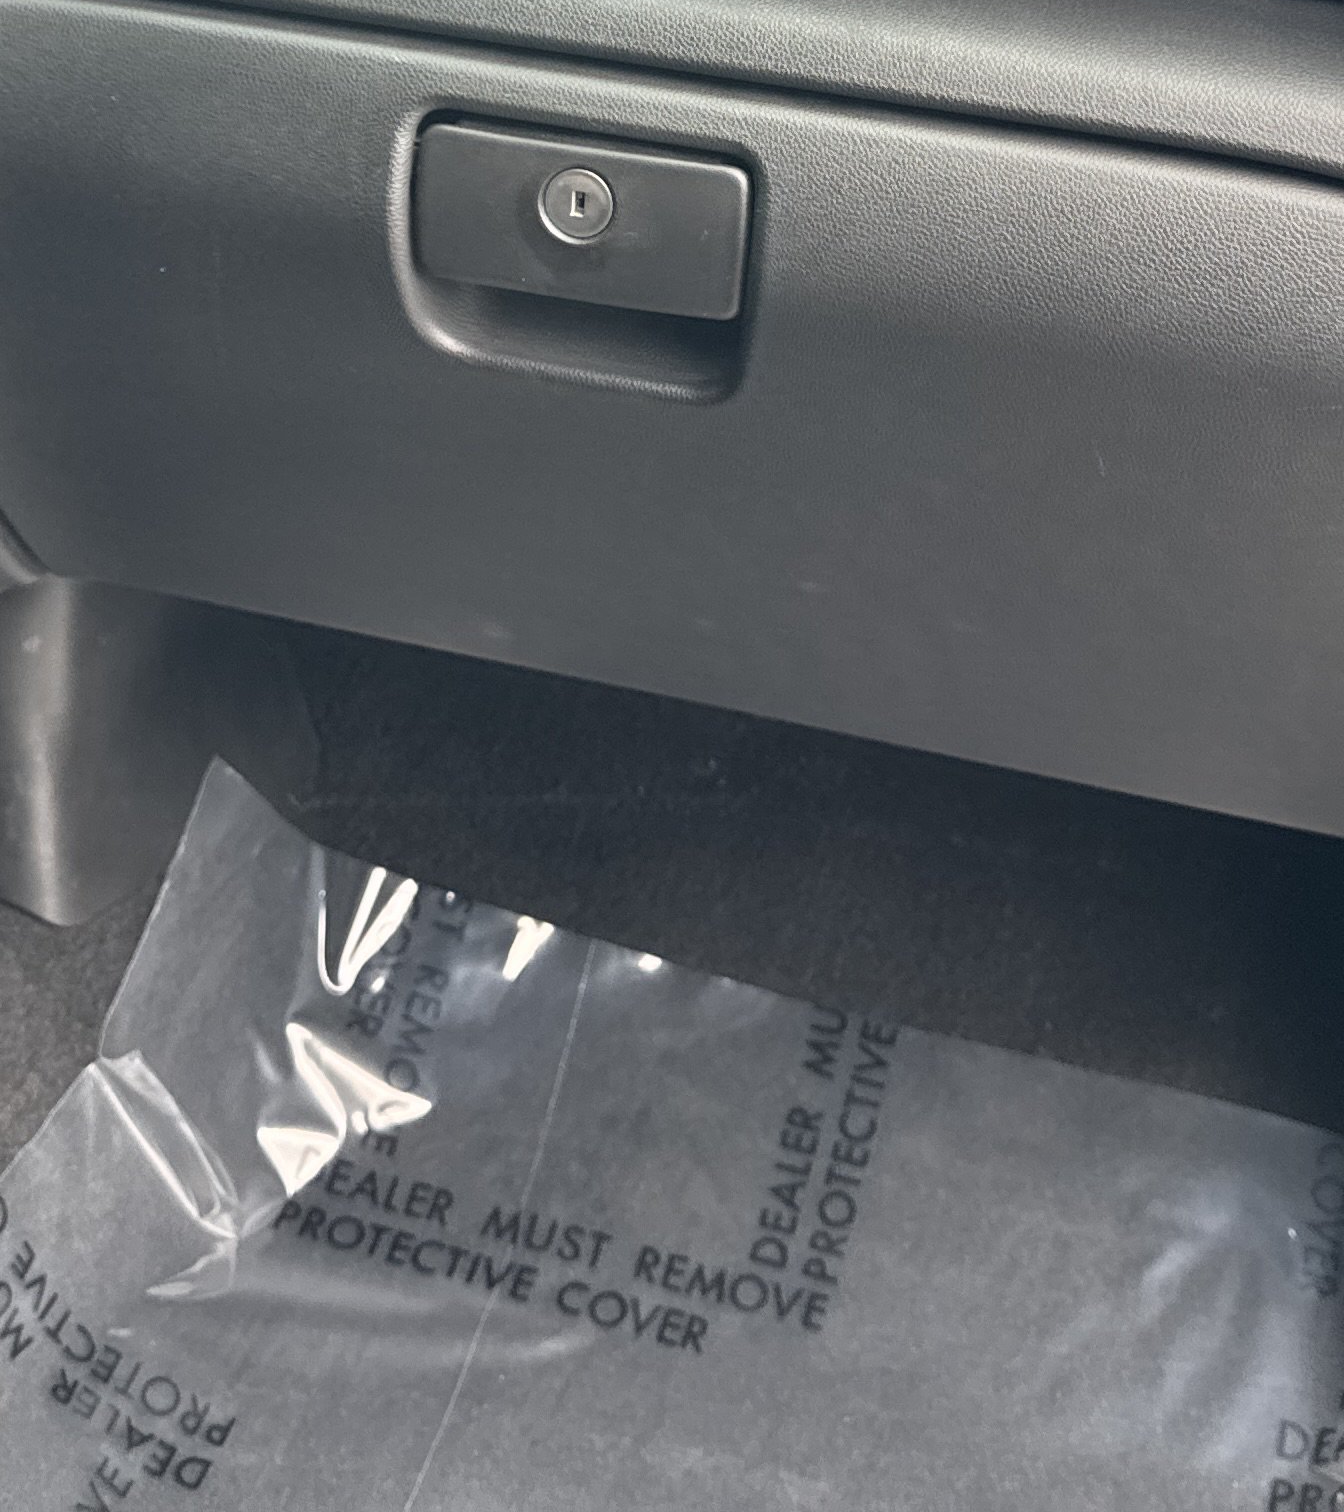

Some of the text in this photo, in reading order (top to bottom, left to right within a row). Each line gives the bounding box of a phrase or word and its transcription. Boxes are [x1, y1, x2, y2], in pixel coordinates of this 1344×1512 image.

[749, 1105, 823, 1269] DEALER
[802, 1017, 900, 1287] PROTECTIVE
[272, 1199, 709, 1354] PROTECTIVE COVER
[318, 1159, 830, 1334] EALER MUST REMOVE
[10, 1240, 237, 1447] PROTECTIVE
[50, 1367, 213, 1490] DEALER
